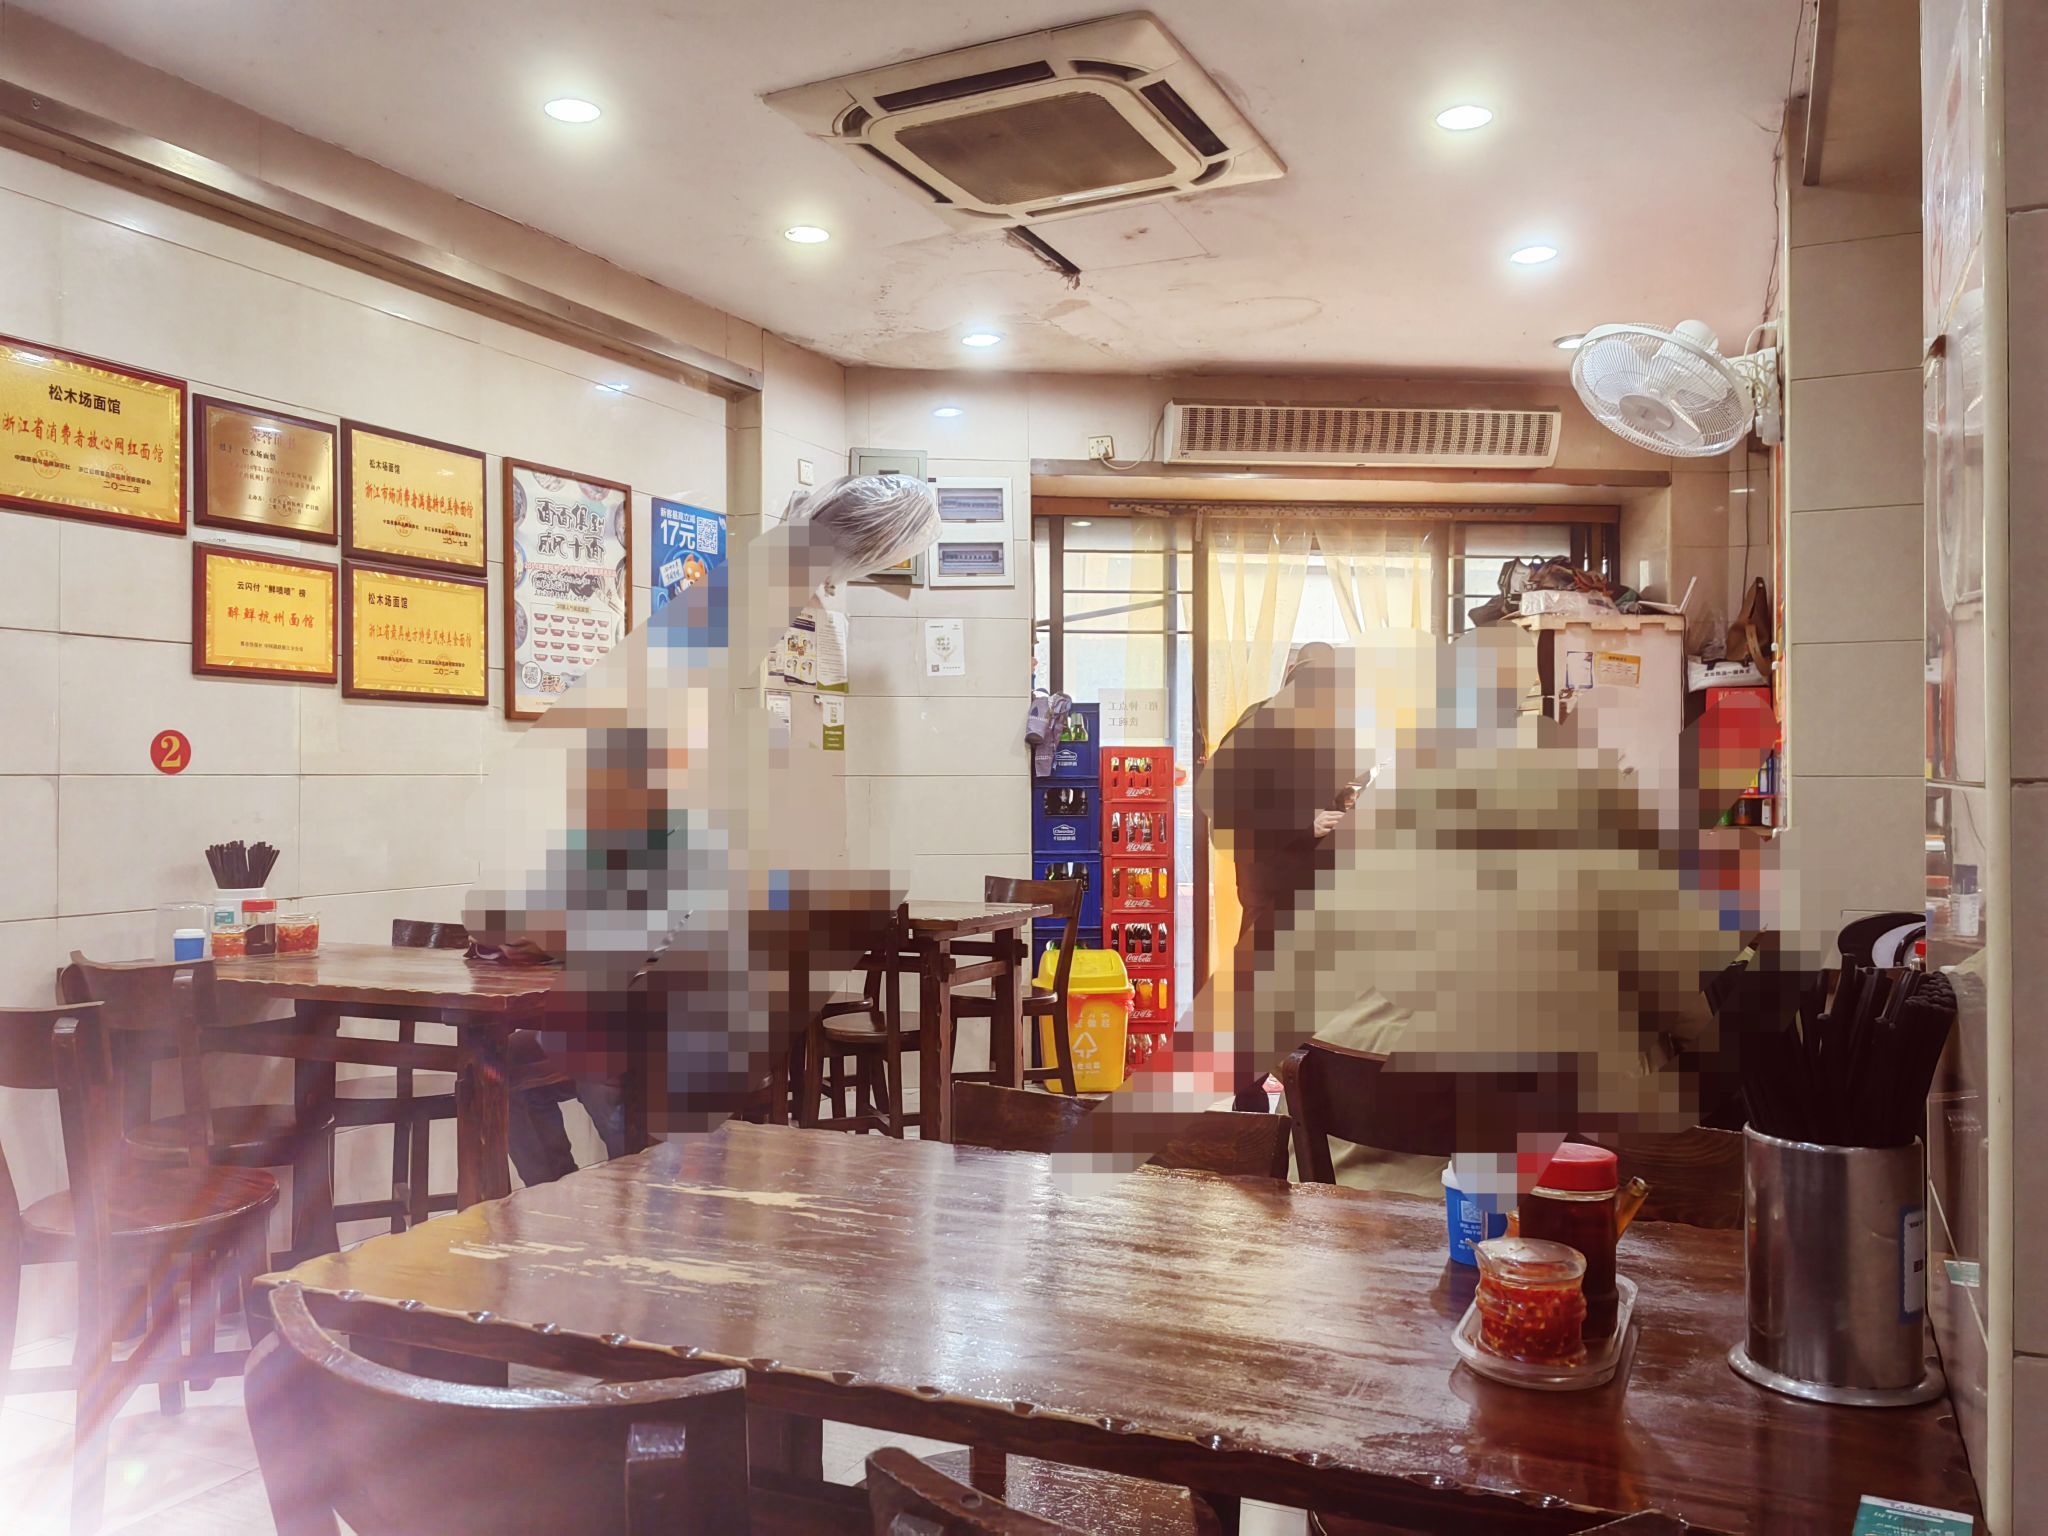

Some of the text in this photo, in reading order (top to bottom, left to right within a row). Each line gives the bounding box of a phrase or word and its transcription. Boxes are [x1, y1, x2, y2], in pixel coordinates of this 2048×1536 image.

[48, 383, 121, 415] 松木场面馆
[2, 412, 164, 464] 浙江省消费者放心网红面馆
[369, 458, 401, 474] 松木场面馆
[365, 479, 473, 519] 浙江市场消费者满意特色美食面馆
[660, 519, 696, 550] 17元
[368, 591, 408, 609] 松木场面馆
[227, 606, 315, 629] 醉鲜杭州面馆
[161, 735, 181, 768] 2
